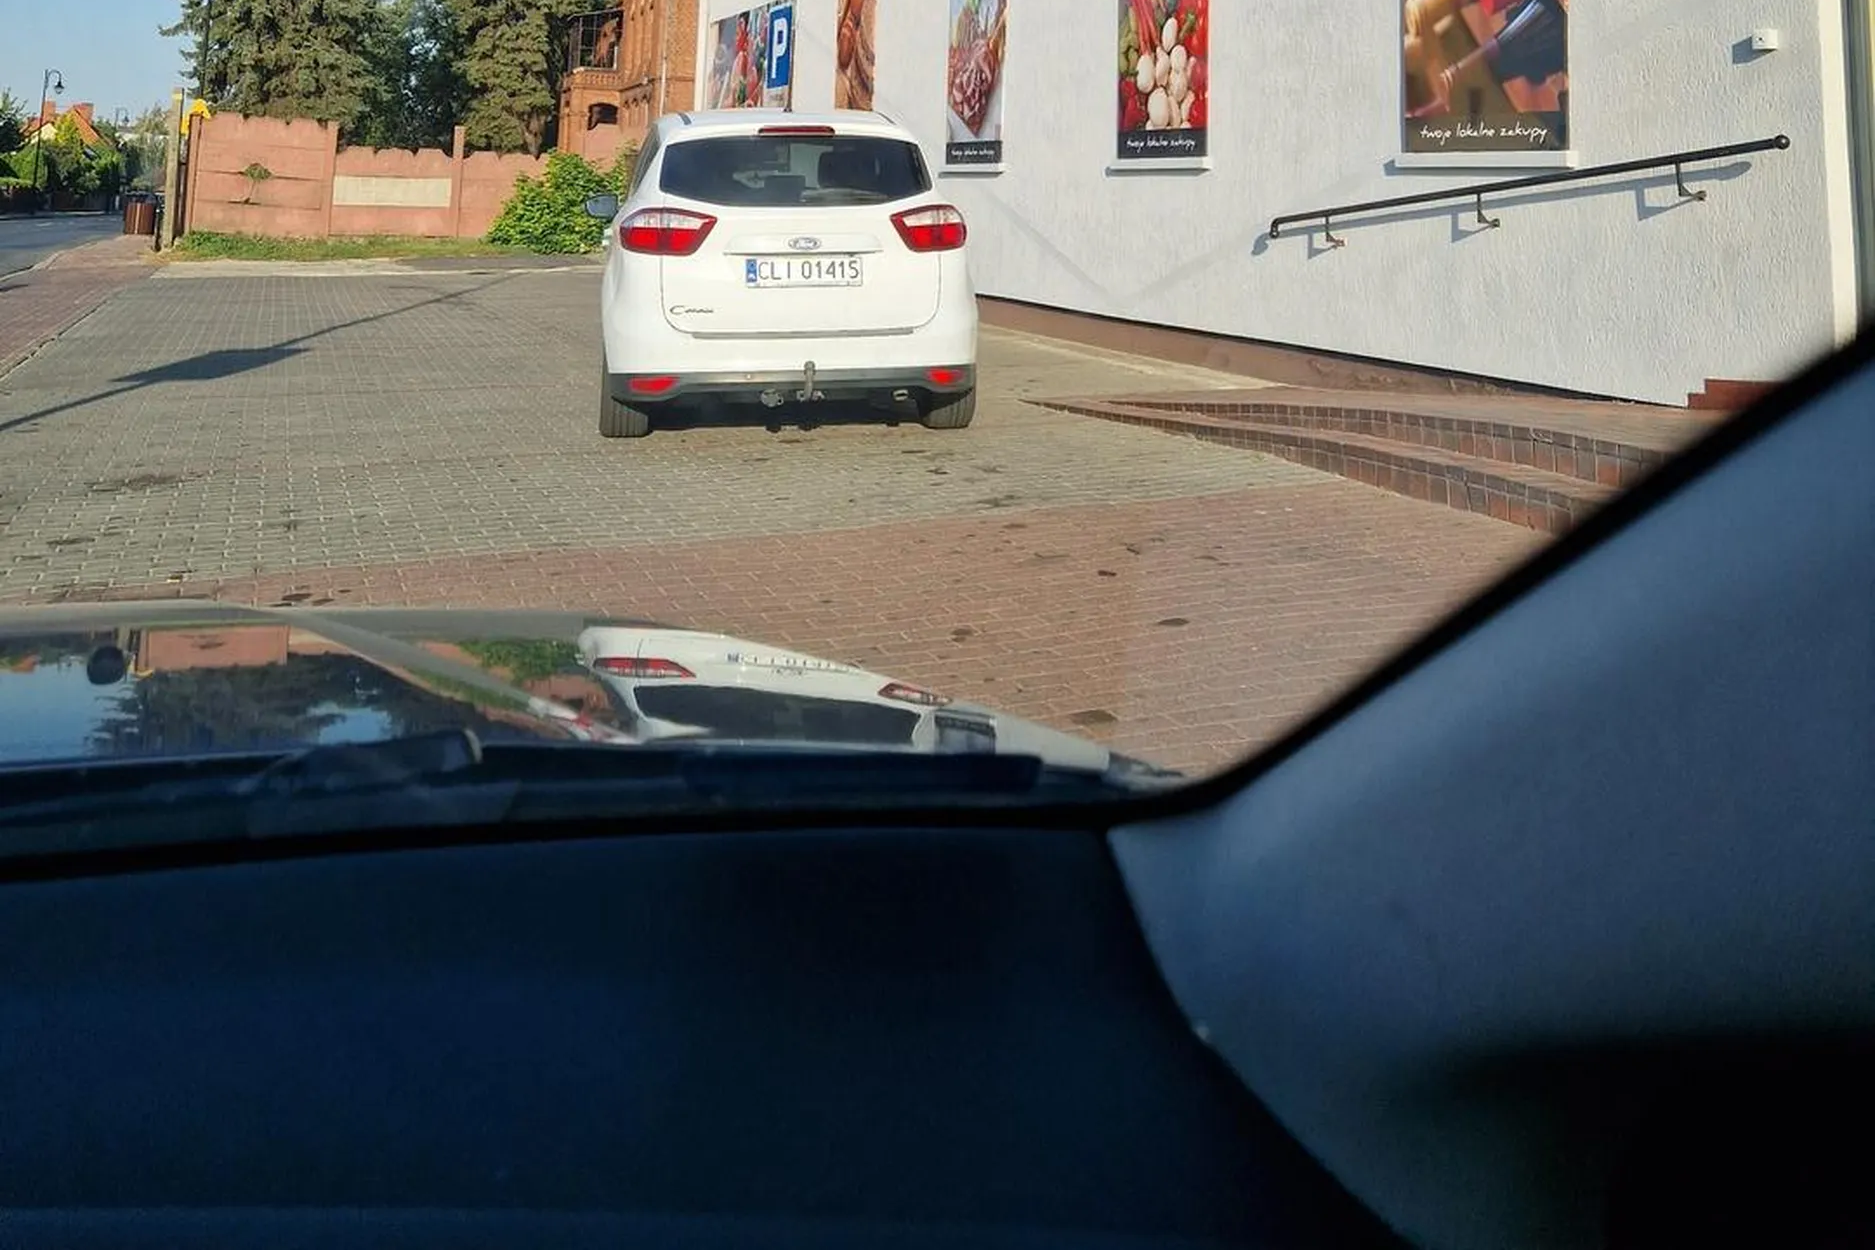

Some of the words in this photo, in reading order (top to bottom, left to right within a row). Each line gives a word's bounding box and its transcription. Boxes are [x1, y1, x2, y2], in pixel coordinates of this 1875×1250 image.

[771, 17, 788, 79] P
[1420, 125, 1451, 146] twoje
[1456, 121, 1495, 138] lokalne
[1500, 121, 1548, 143] zakupy
[758, 260, 791, 280] CLI
[801, 260, 860, 280] 01415
